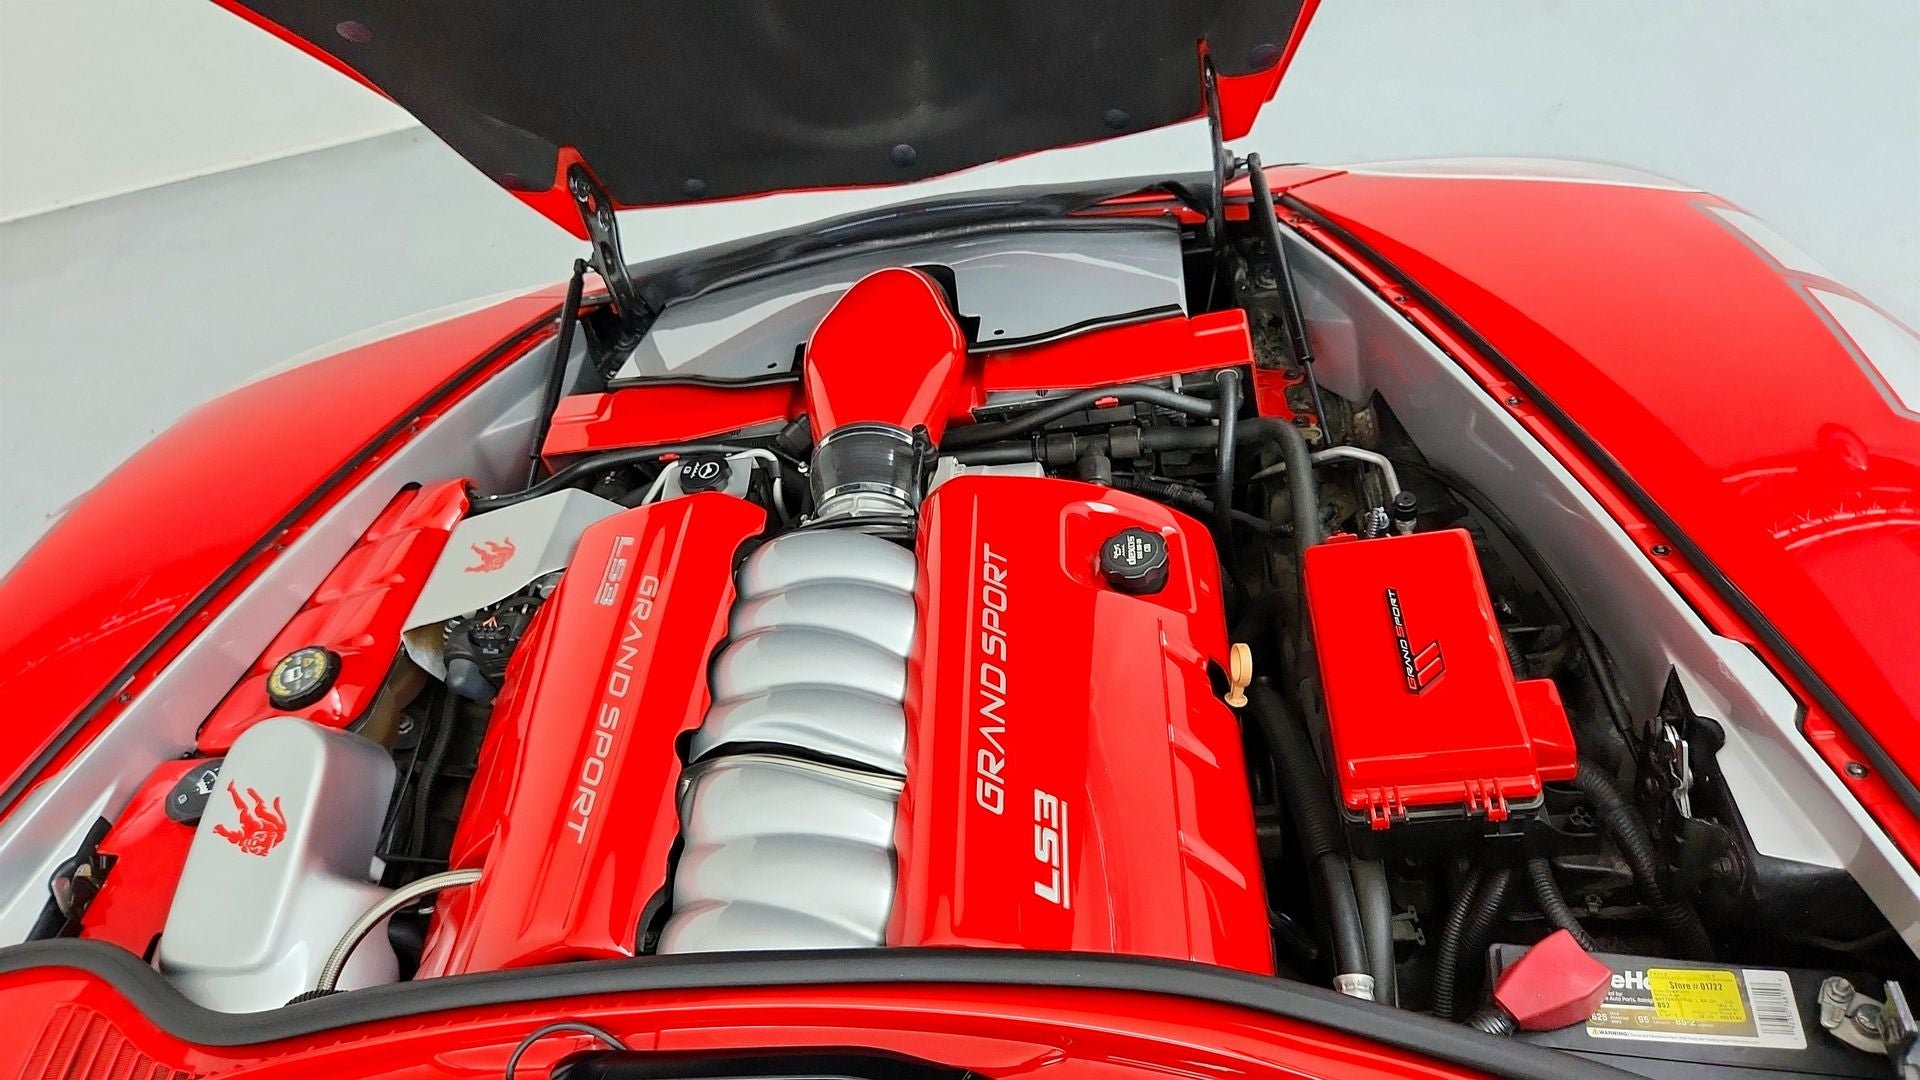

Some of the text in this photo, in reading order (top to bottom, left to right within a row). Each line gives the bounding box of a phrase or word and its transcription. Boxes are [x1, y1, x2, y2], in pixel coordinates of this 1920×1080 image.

[596, 536, 635, 606] LS3
[1126, 534, 1137, 565] dexos
[975, 542, 1008, 816] GRAND SPORT
[1388, 588, 1417, 690] GRAND SPORT
[567, 575, 660, 845] GRAND SPORT
[1033, 788, 1063, 905] LS3
[1669, 981, 1691, 990] Store
[1700, 982, 1723, 991] 01722
